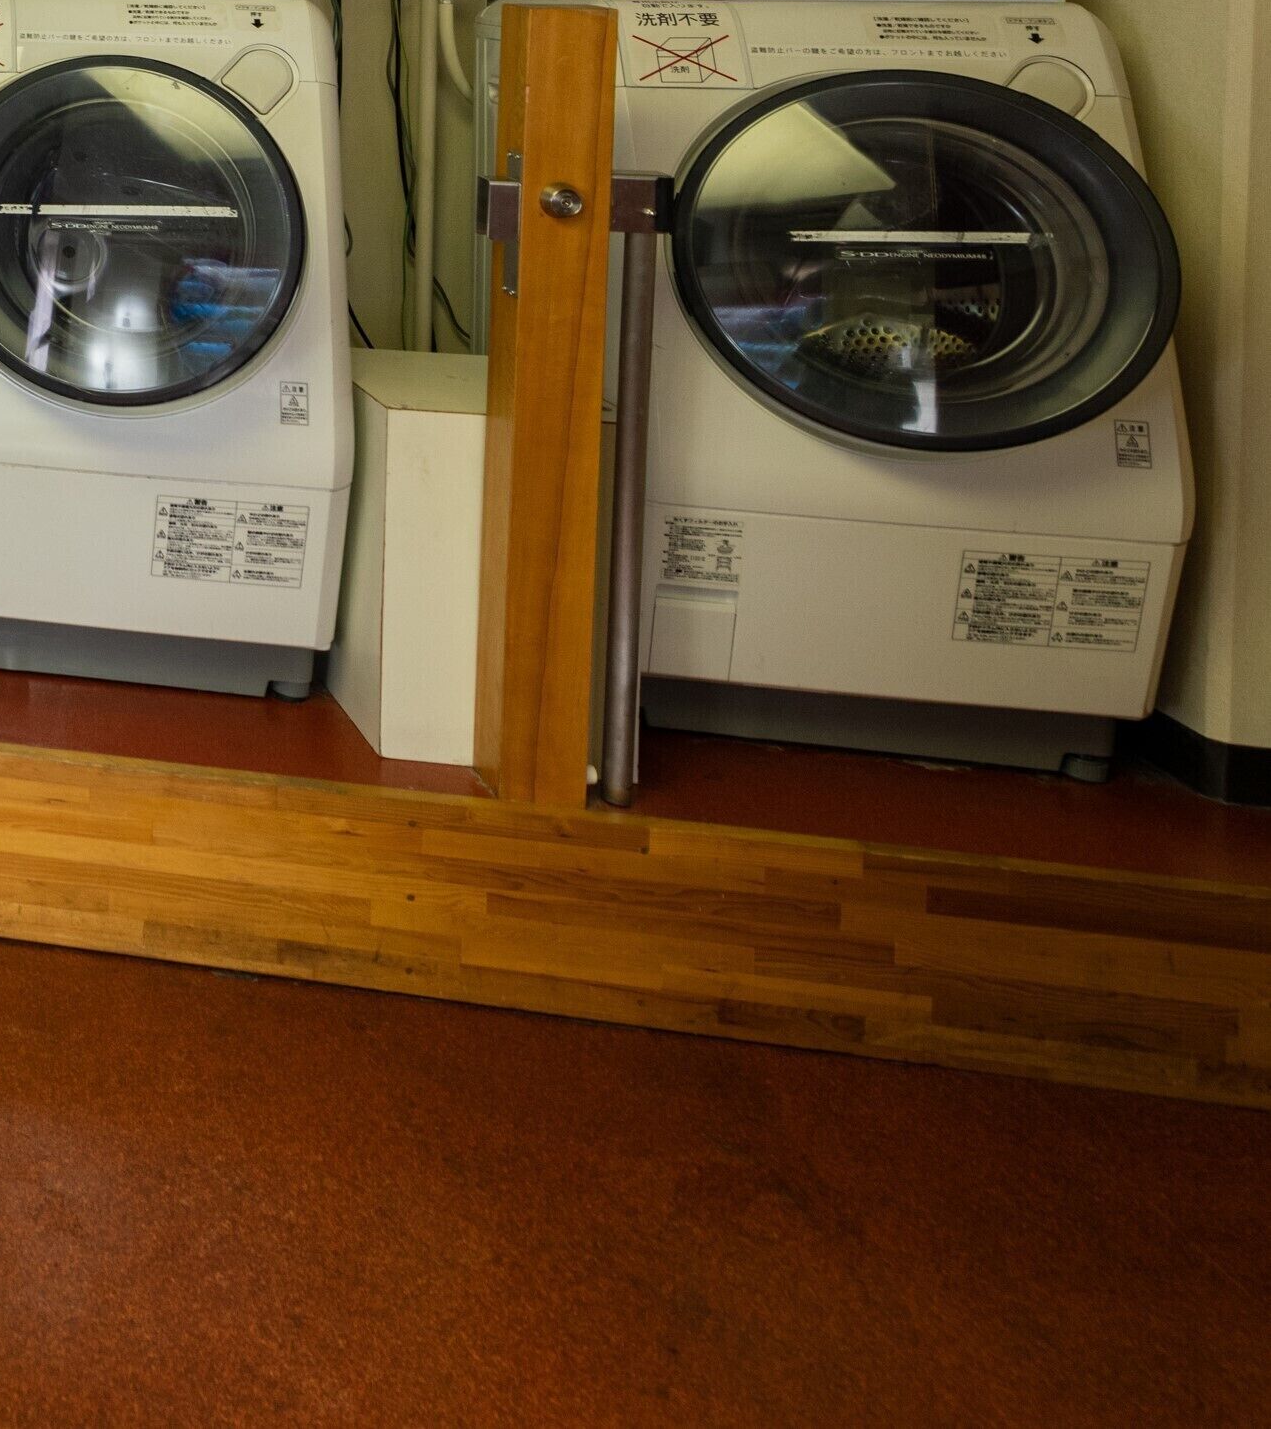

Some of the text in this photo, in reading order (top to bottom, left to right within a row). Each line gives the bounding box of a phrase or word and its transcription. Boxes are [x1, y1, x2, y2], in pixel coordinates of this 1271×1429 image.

[635, 11, 720, 28] 洗剤不要
[670, 65, 690, 74] 洗剤
